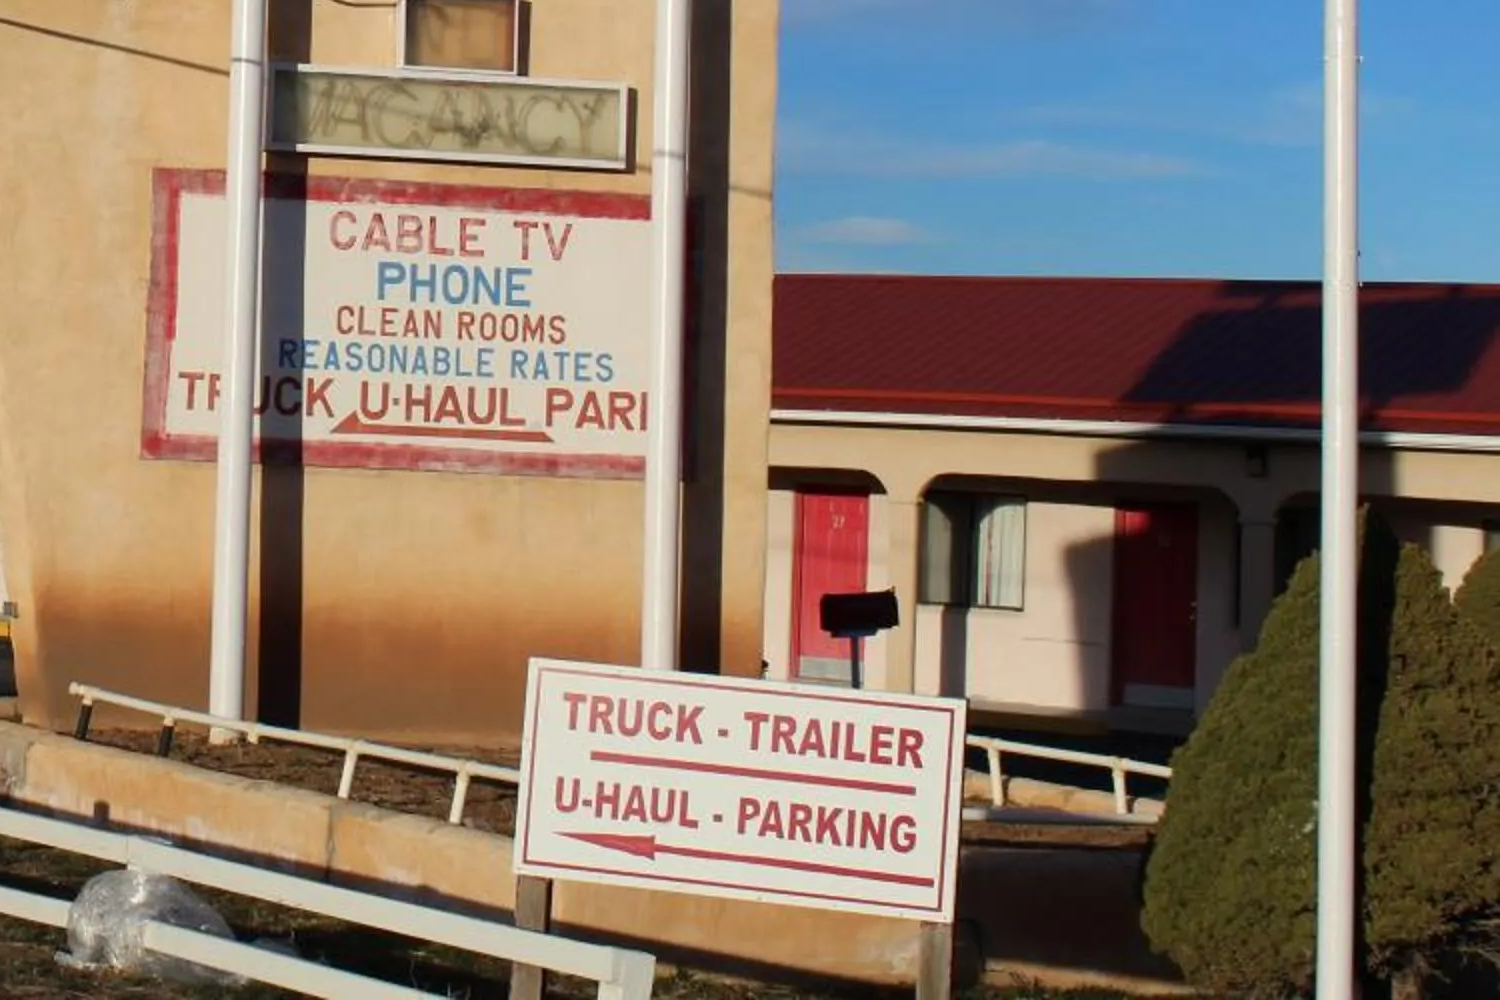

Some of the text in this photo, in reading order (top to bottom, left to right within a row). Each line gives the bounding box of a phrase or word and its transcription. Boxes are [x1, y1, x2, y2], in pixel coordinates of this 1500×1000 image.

[329, 210, 574, 262] CABLE TV
[376, 261, 533, 308] PHONE
[336, 304, 567, 345] CLEAN ROOMS
[278, 338, 615, 383] REASONABLE RATES
[358, 379, 527, 428] U-HAUL
[544, 387, 649, 432] PAR
[563, 692, 705, 745] TRUCK
[743, 711, 925, 769] TRAILER
[554, 775, 699, 829] U-HAUL
[736, 797, 918, 854] PARKING
